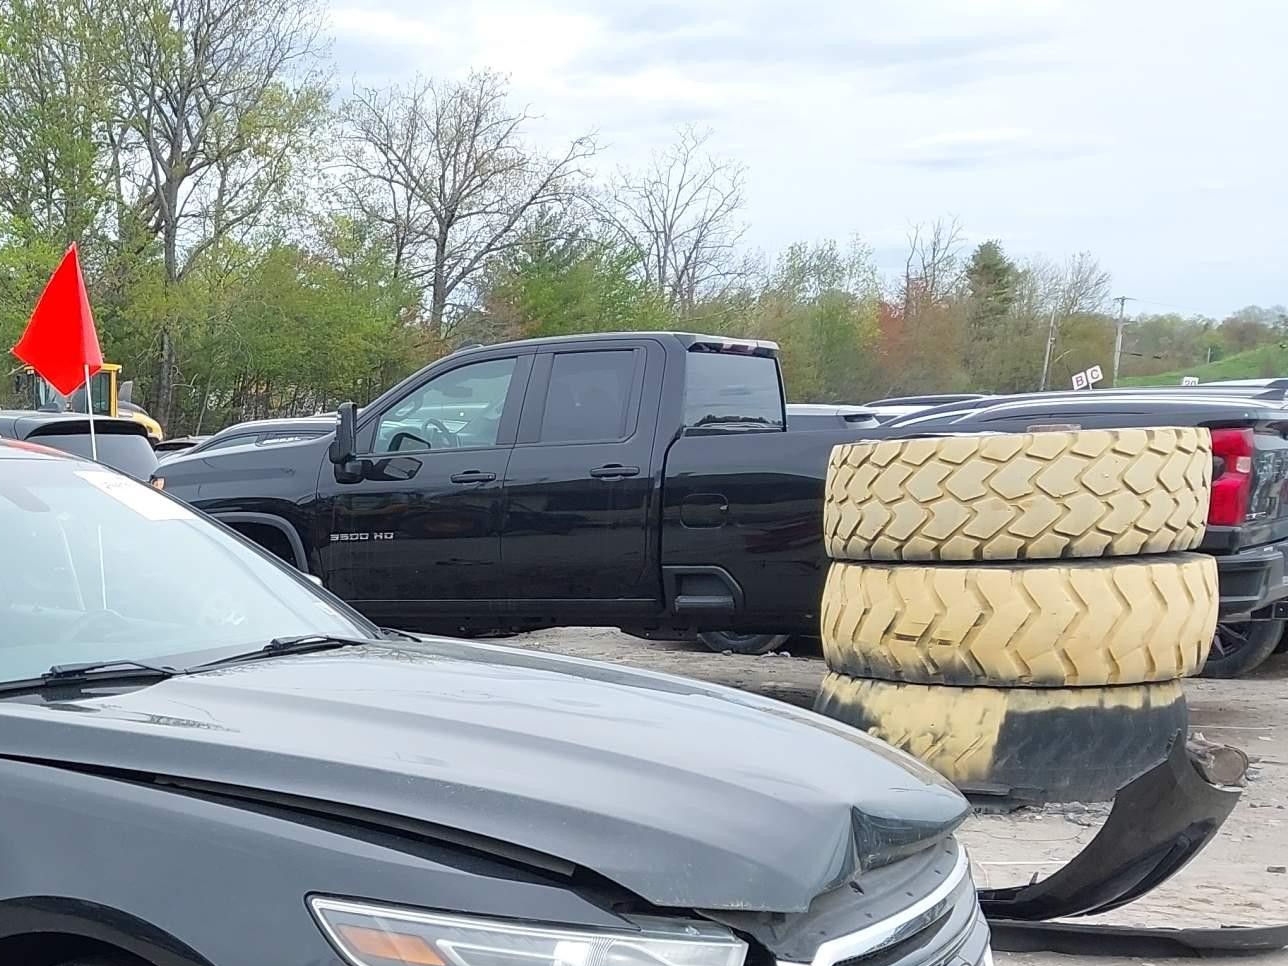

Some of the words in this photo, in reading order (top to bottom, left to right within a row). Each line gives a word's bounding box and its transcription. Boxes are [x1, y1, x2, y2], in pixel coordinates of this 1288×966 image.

[1091, 369, 1100, 379] C
[1075, 376, 1084, 386] B
[373, 532, 394, 540] HD
